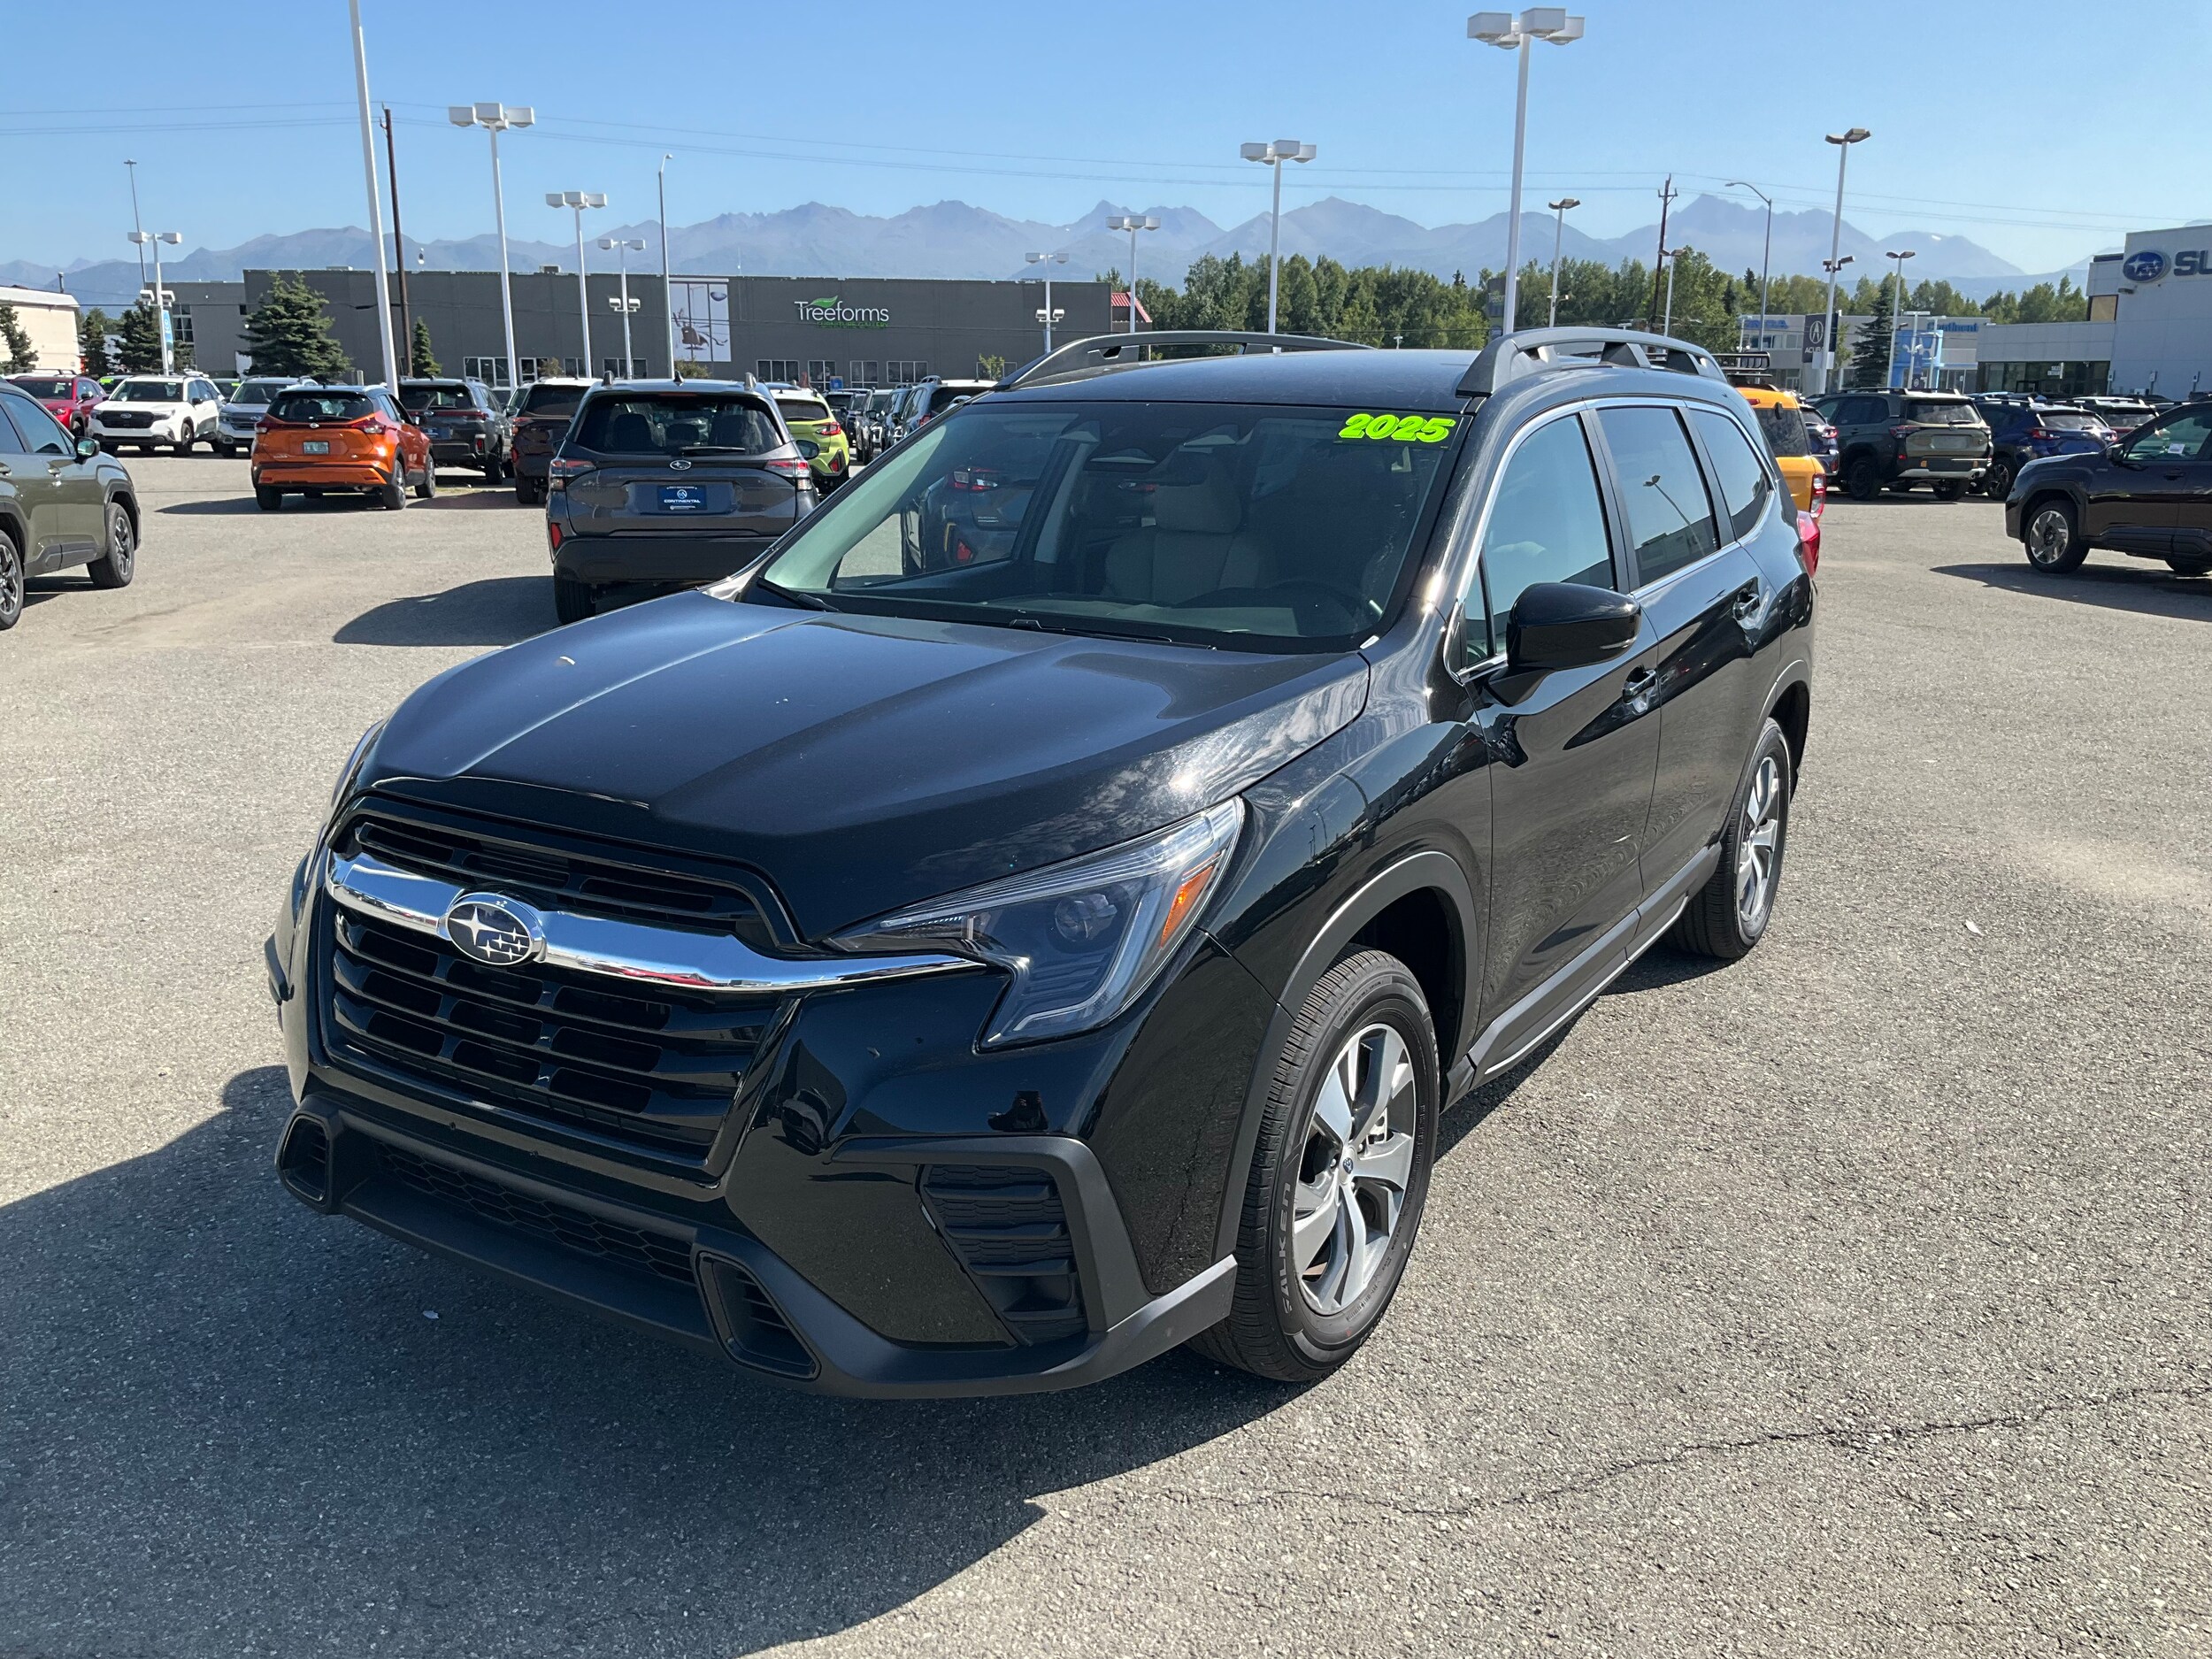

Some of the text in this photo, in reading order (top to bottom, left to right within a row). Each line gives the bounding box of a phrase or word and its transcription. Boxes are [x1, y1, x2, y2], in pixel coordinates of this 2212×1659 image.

[794, 300, 889, 322] Treeforms
[1338, 413, 1456, 442] 2025
[1279, 1182, 1293, 1314] FALKEN
